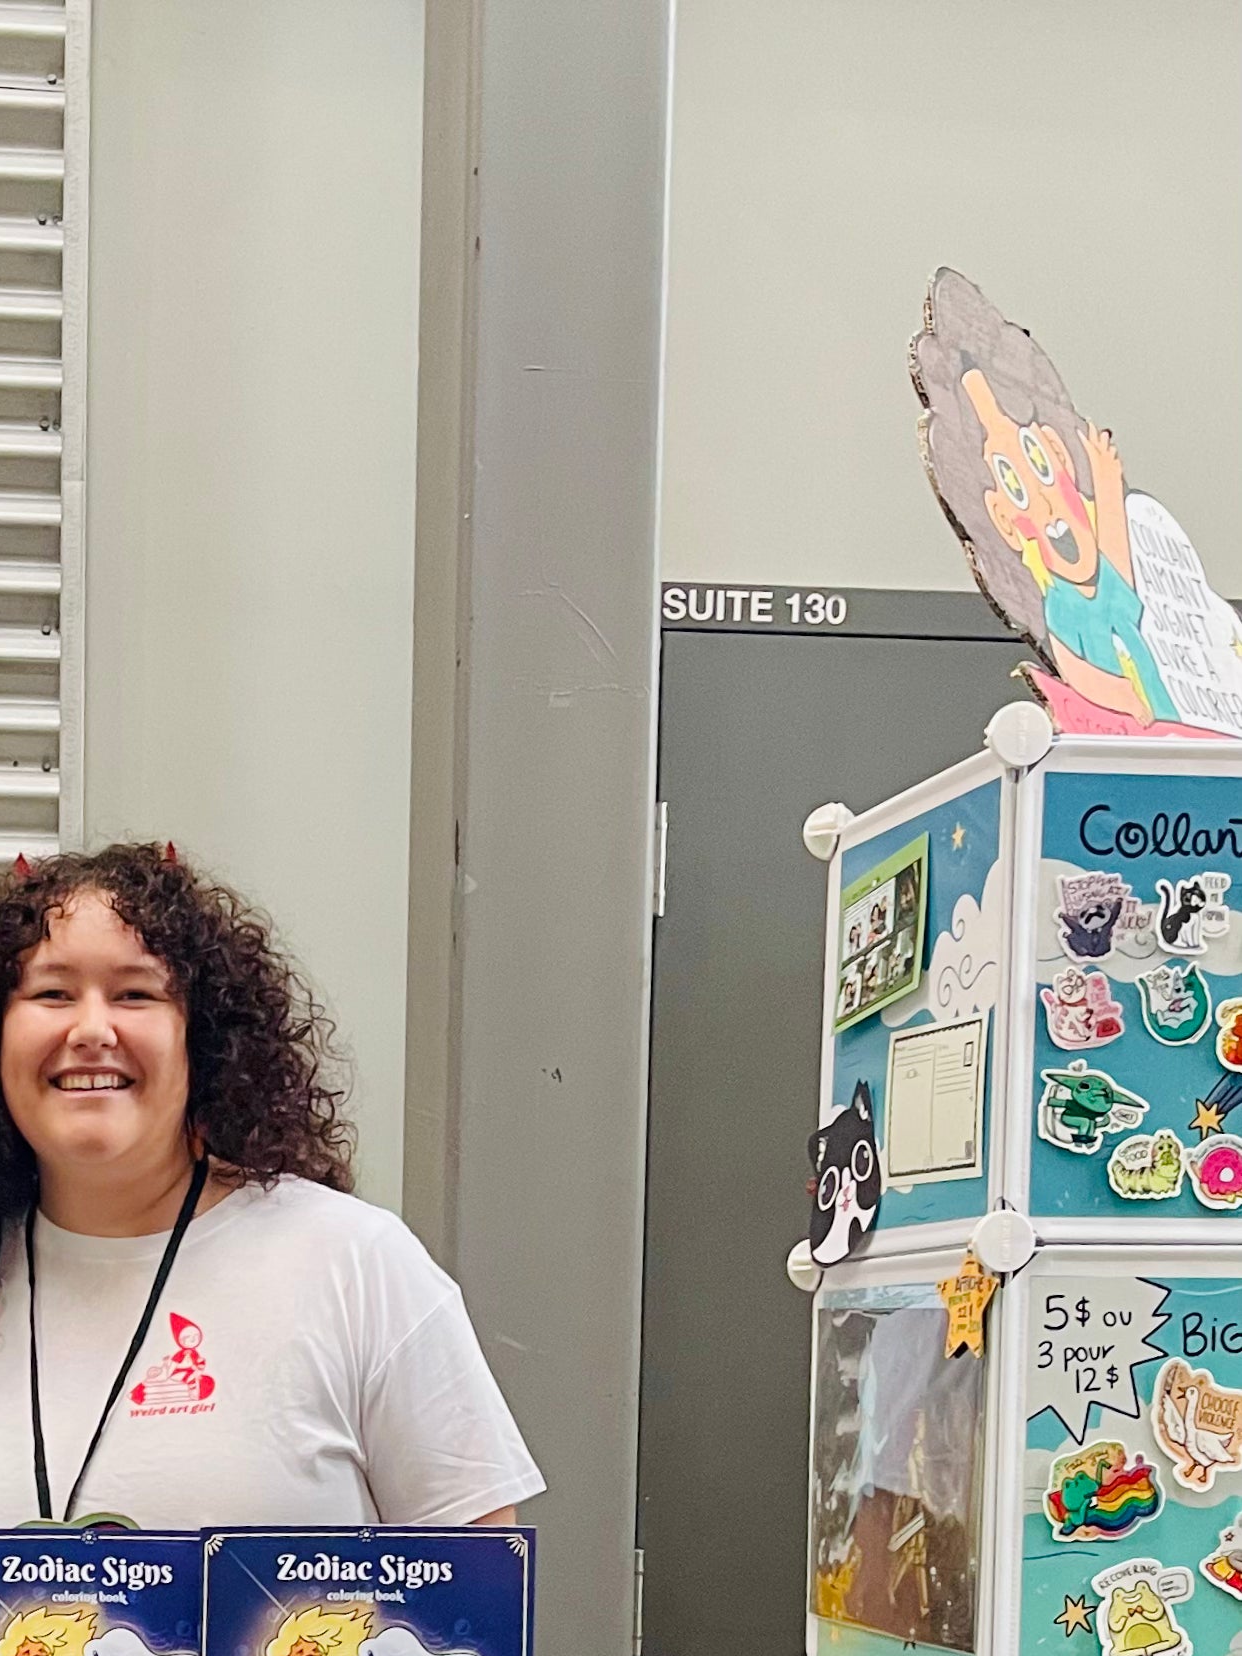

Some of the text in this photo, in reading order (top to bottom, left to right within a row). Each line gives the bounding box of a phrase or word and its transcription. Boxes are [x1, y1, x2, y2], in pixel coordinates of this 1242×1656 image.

[662, 588, 847, 625] SUITE 130
[1144, 594, 1213, 648] SIGNET
[1103, 1311, 1132, 1327] ou
[1038, 1340, 1115, 1372] 3 pour
[130, 1403, 216, 1418] Weird art girl
[1201, 1392, 1239, 1413] CHOOSE
[1, 1555, 173, 1591] Zodiac Signs
[276, 1553, 453, 1590] Zodiac Signs
[1098, 1564, 1158, 1589] RECOVERING
[52, 1590, 129, 1605] coloring book
[326, 1589, 406, 1604] coloring book
